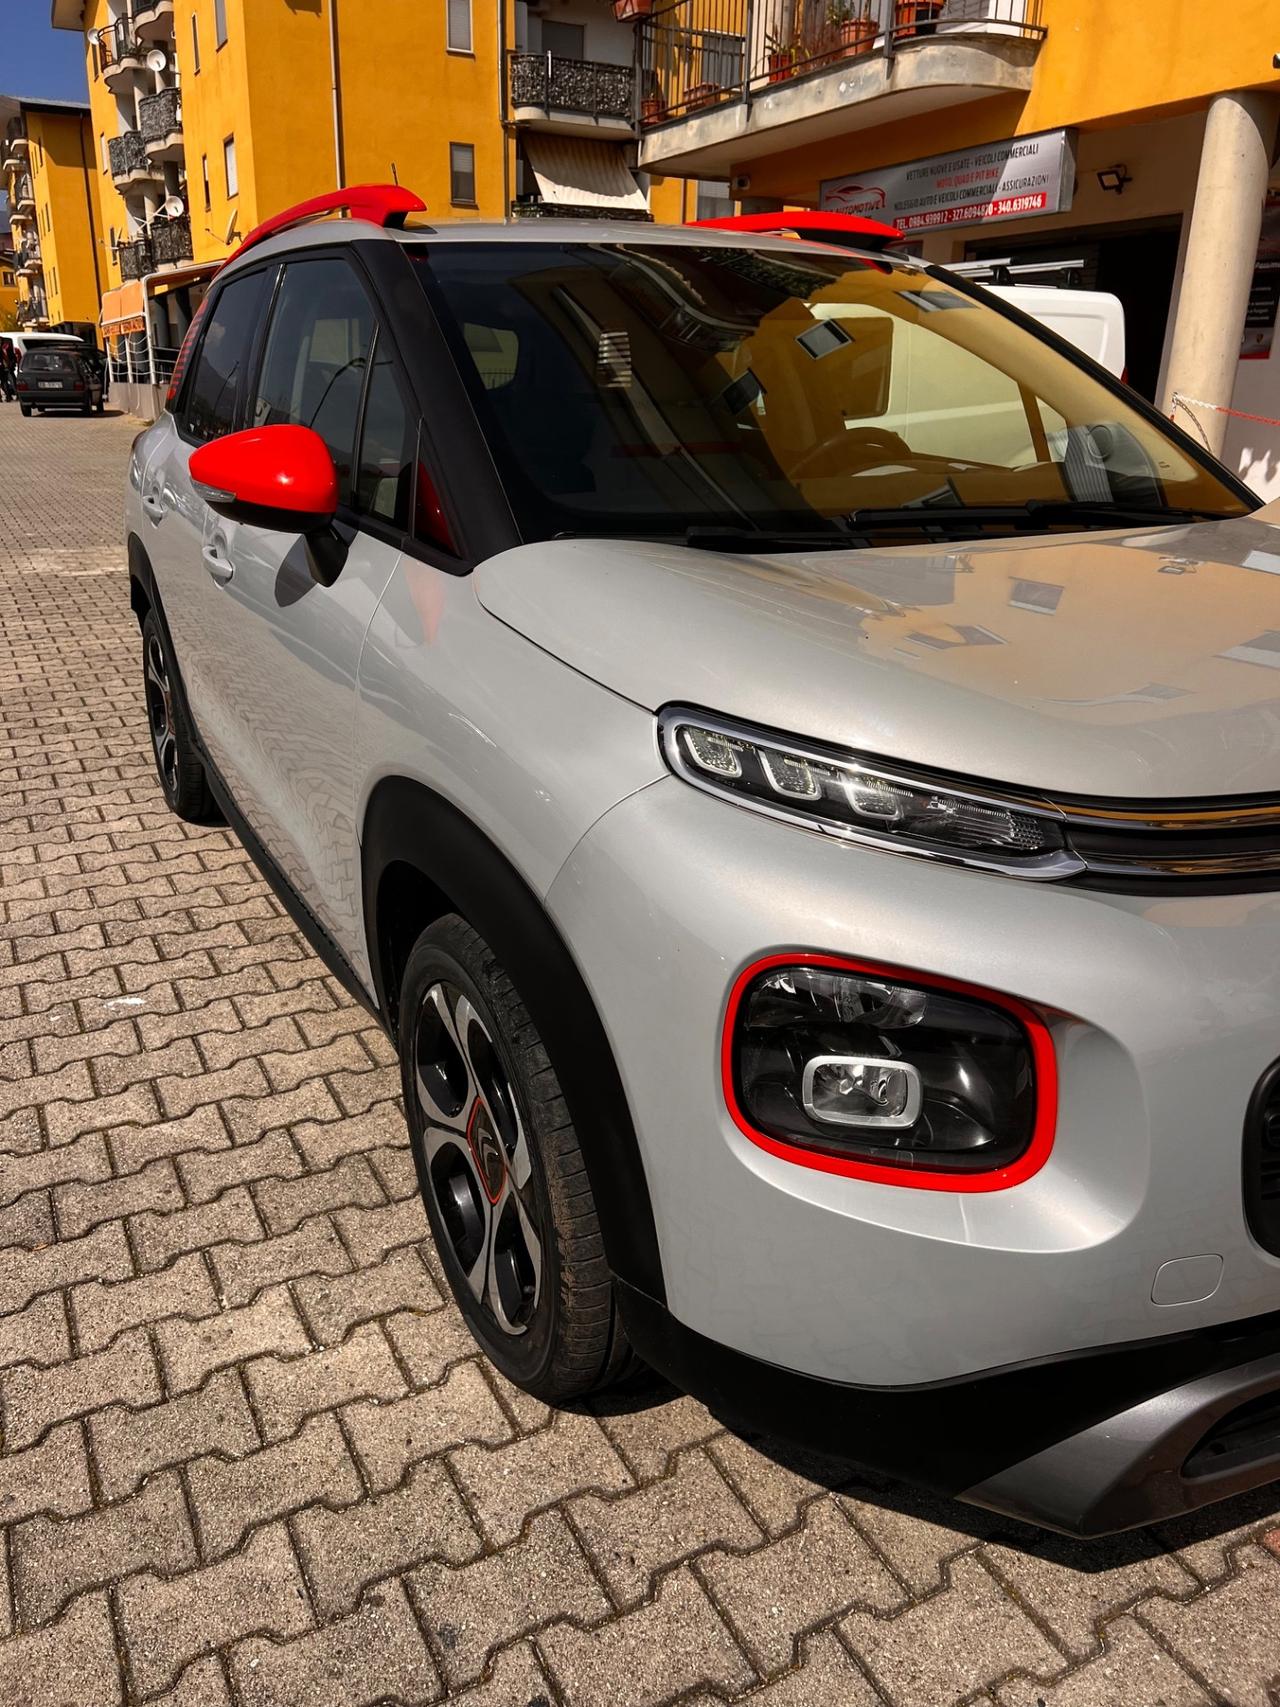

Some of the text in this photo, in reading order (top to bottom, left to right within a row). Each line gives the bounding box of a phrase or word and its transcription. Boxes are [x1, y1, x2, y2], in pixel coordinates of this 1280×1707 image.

[930, 163, 948, 177] NUOVE
[953, 158, 970, 172] USATE
[974, 152, 996, 167] VEICOLI
[996, 144, 1039, 163] COMMERCIALI
[975, 171, 986, 181] PIT
[986, 168, 1000, 179] BIKE
[894, 196, 919, 211] NOLEGGIO
[919, 194, 934, 207] AUTO
[938, 190, 959, 204] VEICOLI
[959, 182, 998, 201] COMMERCIALI
[1002, 174, 1049, 192] ASSICURAZIONI
[896, 217, 908, 230] TEL.
[998, 194, 1042, 215] 340.6319746
